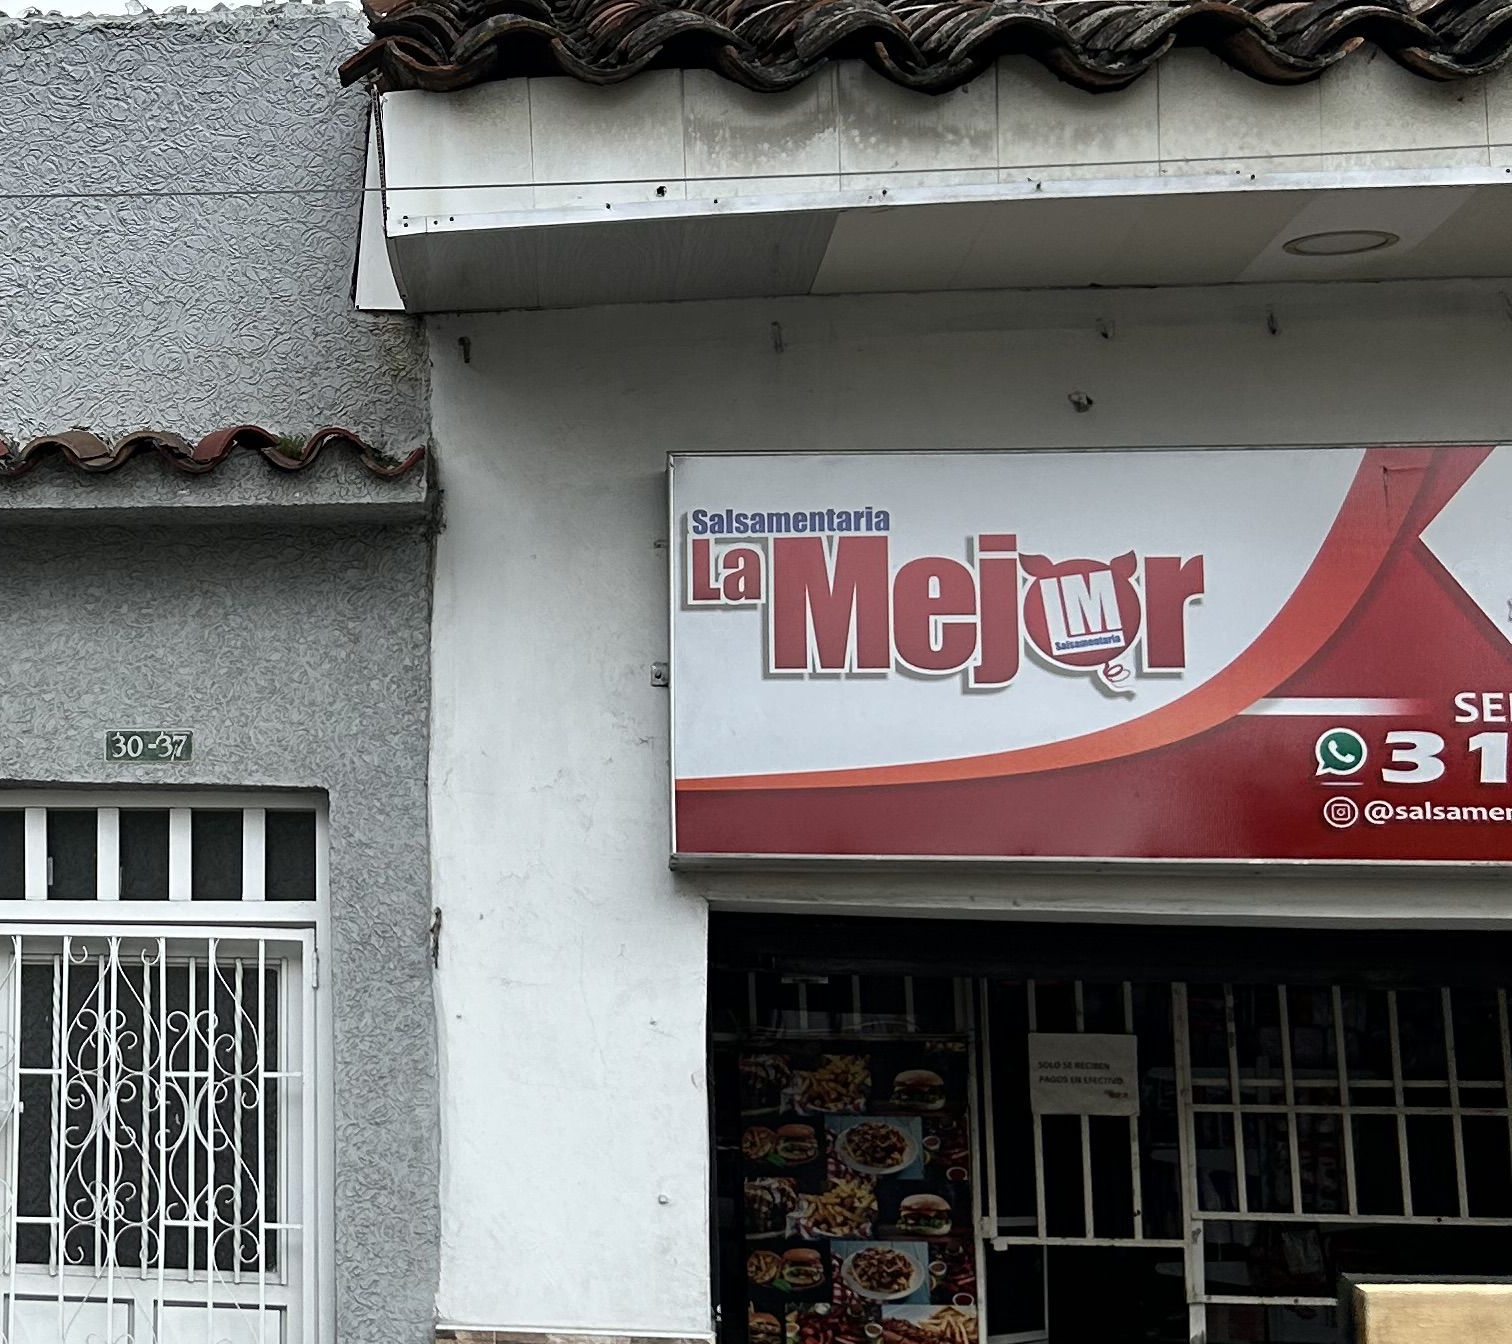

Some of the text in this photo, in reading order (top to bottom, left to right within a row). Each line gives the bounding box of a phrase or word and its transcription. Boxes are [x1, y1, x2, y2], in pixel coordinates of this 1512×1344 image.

[692, 506, 890, 535] Salsamentaria
[692, 538, 762, 602] La
[1054, 633, 1122, 652] Salsamentaria
[1454, 692, 1512, 723] SE
[1038, 1062, 1110, 1070] SOLO SE RECIBEN
[1039, 1076, 1068, 1084] PAGOS
[1070, 1076, 1082, 1084] EN
